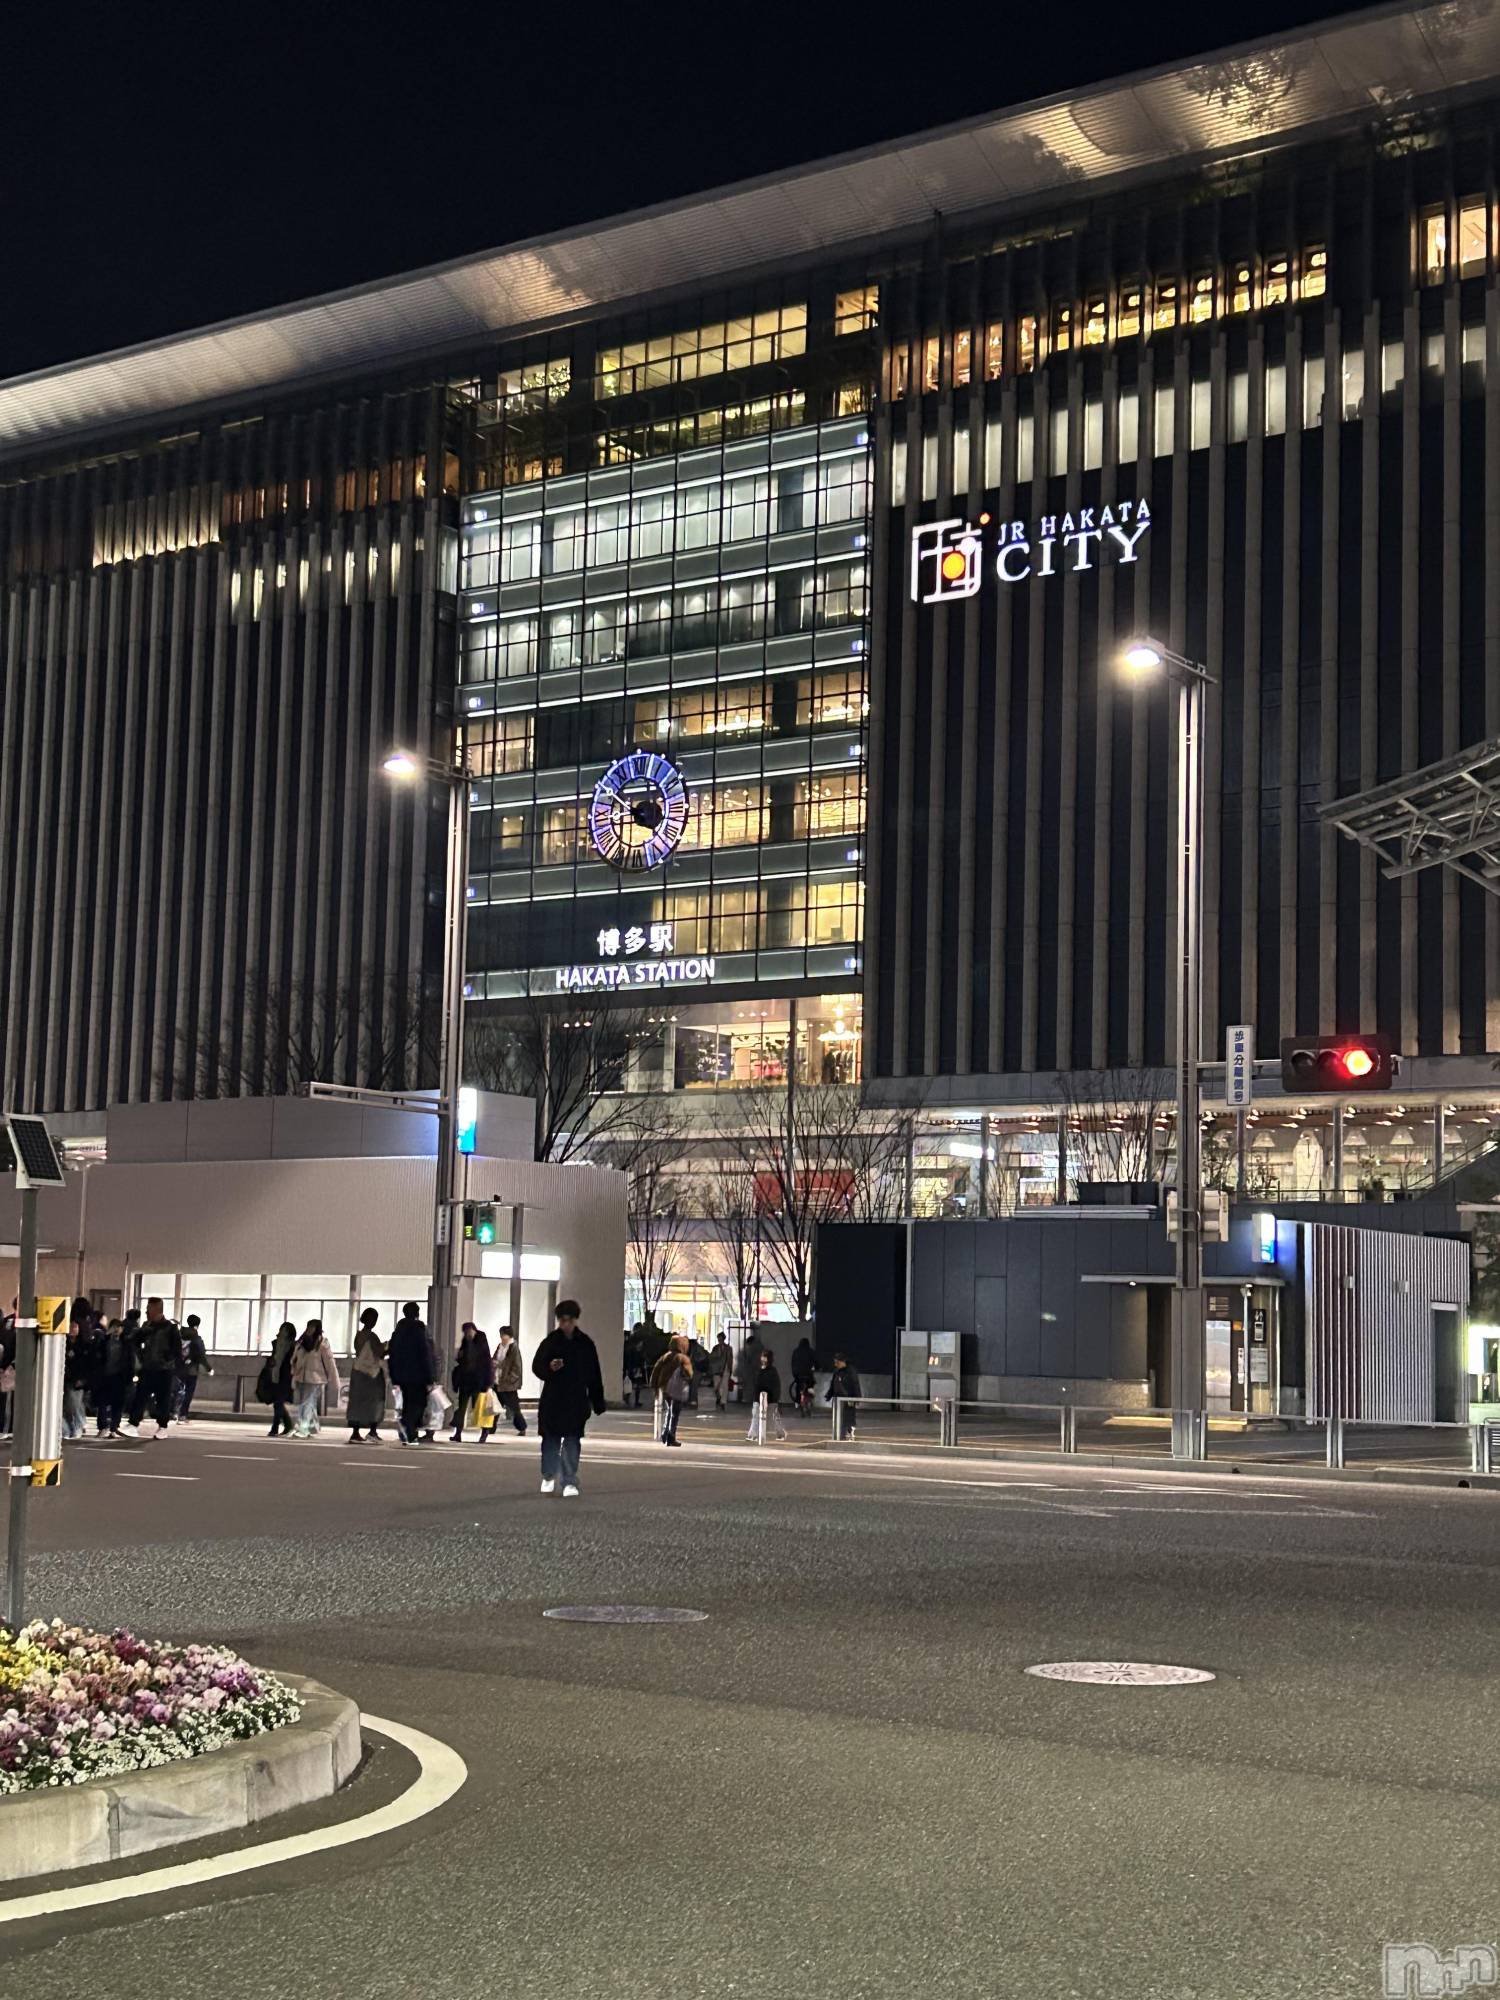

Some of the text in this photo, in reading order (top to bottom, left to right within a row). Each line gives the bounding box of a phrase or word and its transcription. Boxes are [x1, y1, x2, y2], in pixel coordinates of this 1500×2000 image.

[997, 498, 1150, 545] JR HAKATA
[996, 521, 1150, 582] CITY
[597, 924, 674, 956] 博多駅
[555, 958, 715, 989] HAKATA STATION
[1233, 1030, 1245, 1103] 歩分号
